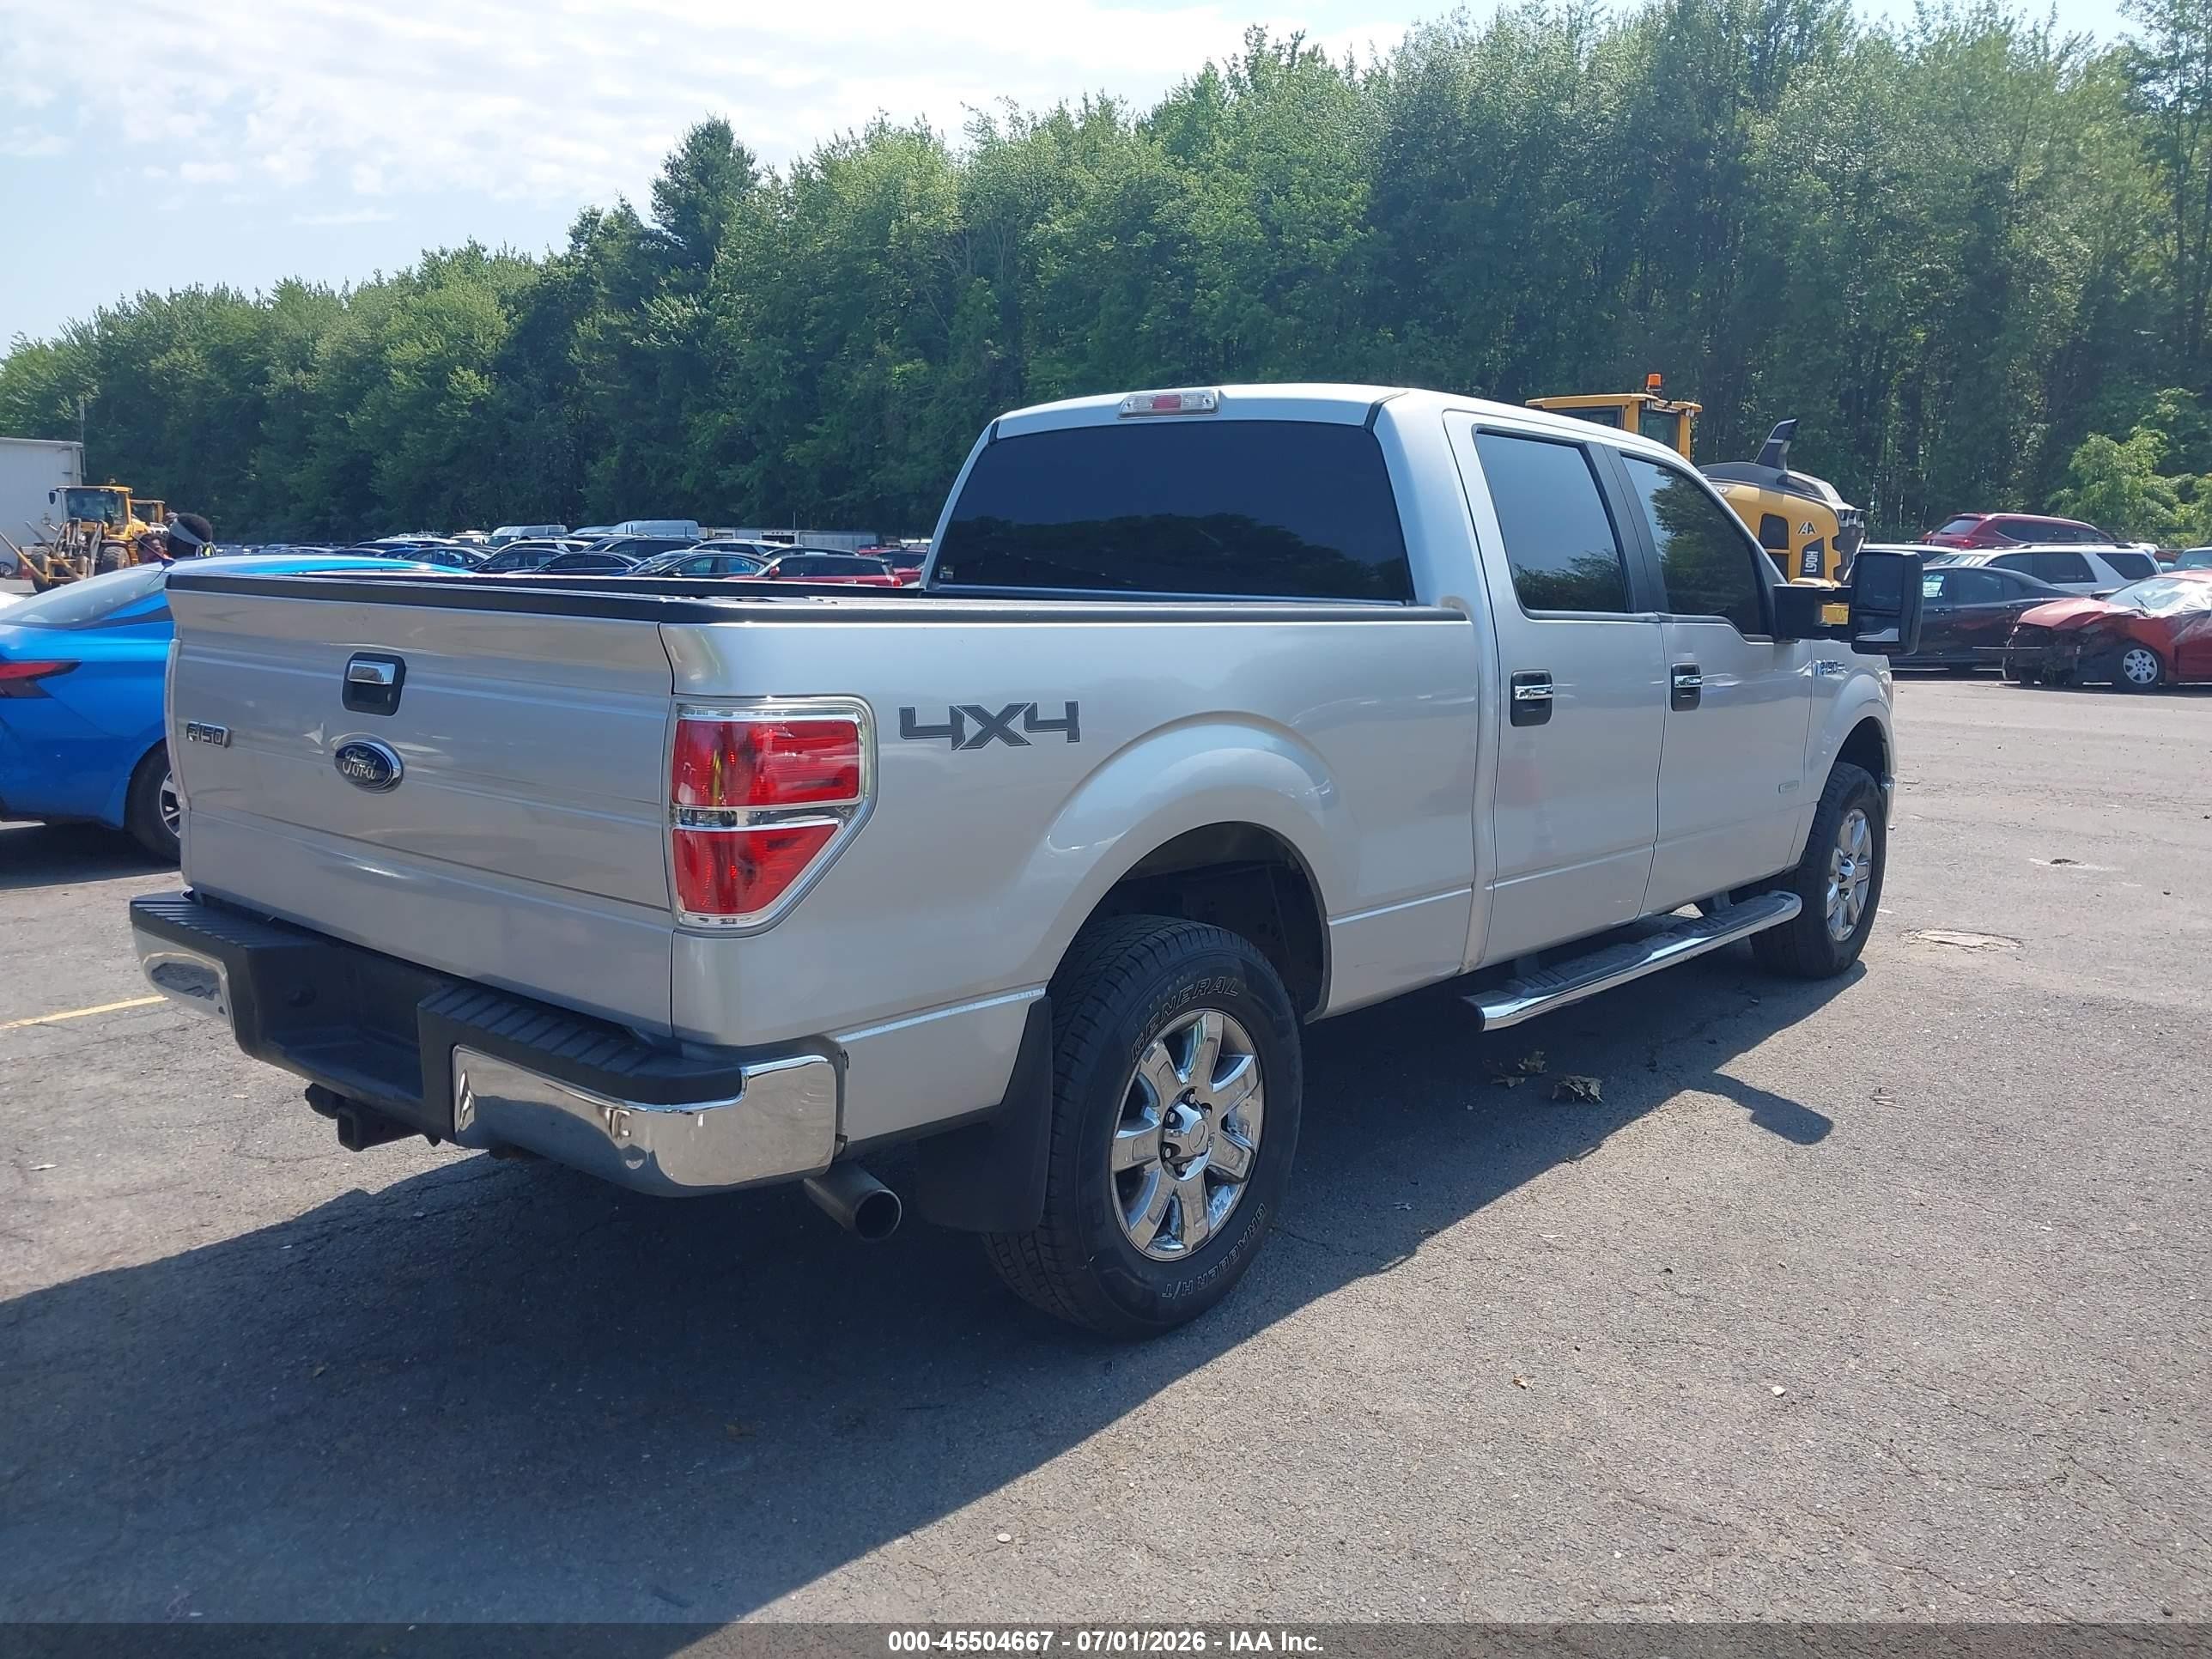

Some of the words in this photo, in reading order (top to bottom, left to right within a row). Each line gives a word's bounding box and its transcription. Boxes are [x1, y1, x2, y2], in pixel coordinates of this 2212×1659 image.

[1804, 550, 1819, 573] L90H
[342, 747, 378, 780] Ford
[1131, 976, 1239, 1064] GENERAL
[1196, 1202, 1267, 1288] GRABBER
[1161, 1279, 1194, 1299] H/T
